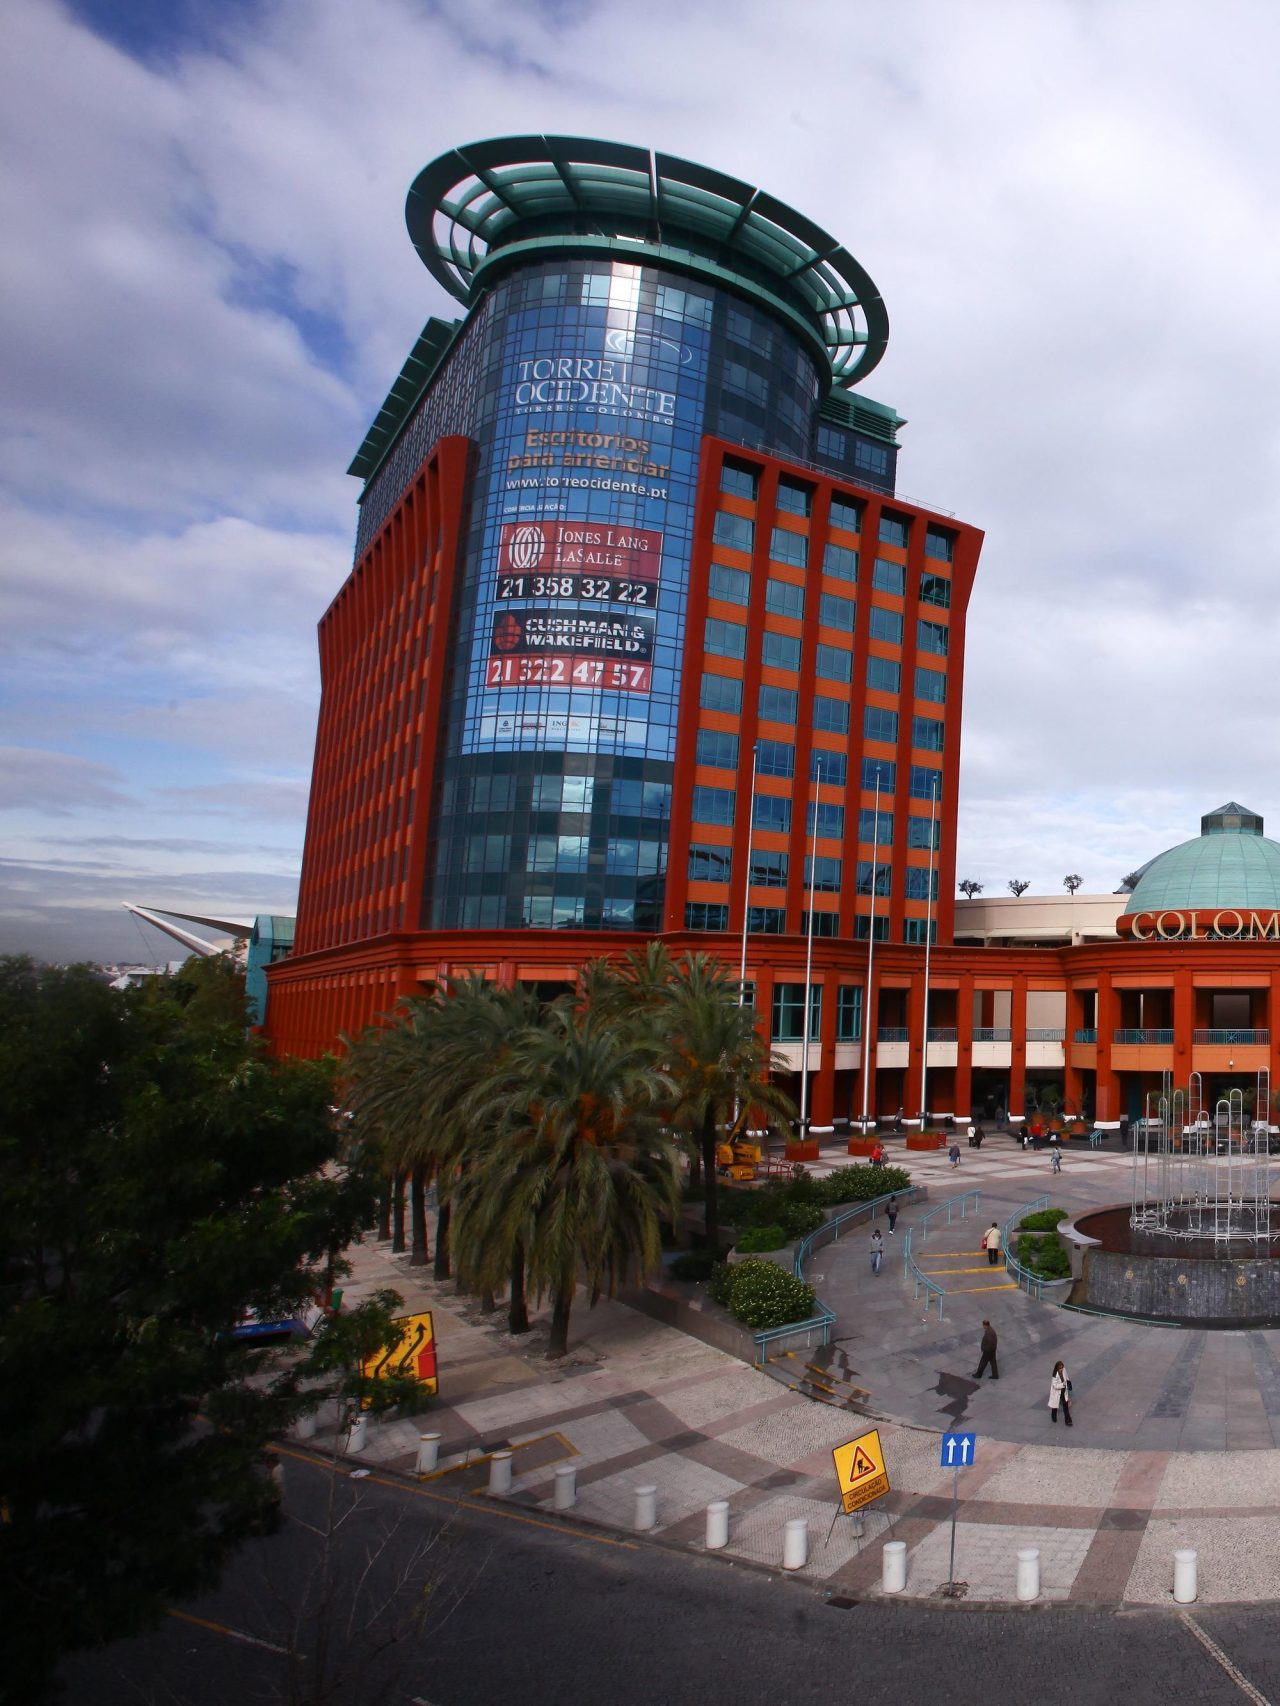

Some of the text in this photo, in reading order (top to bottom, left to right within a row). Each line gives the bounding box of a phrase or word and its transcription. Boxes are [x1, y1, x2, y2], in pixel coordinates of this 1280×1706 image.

[519, 358, 615, 382] TORRE
[515, 380, 676, 416] OCIDENTE
[515, 404, 674, 426] TORRES COLOMBO
[507, 451, 670, 479] para arrendar
[501, 577, 648, 604] 21 358 32 22
[525, 618, 646, 640] CUSHMAN &
[491, 660, 512, 682] 21
[519, 659, 565, 682] 322
[573, 661, 604, 684] 47
[611, 664, 645, 688] 57
